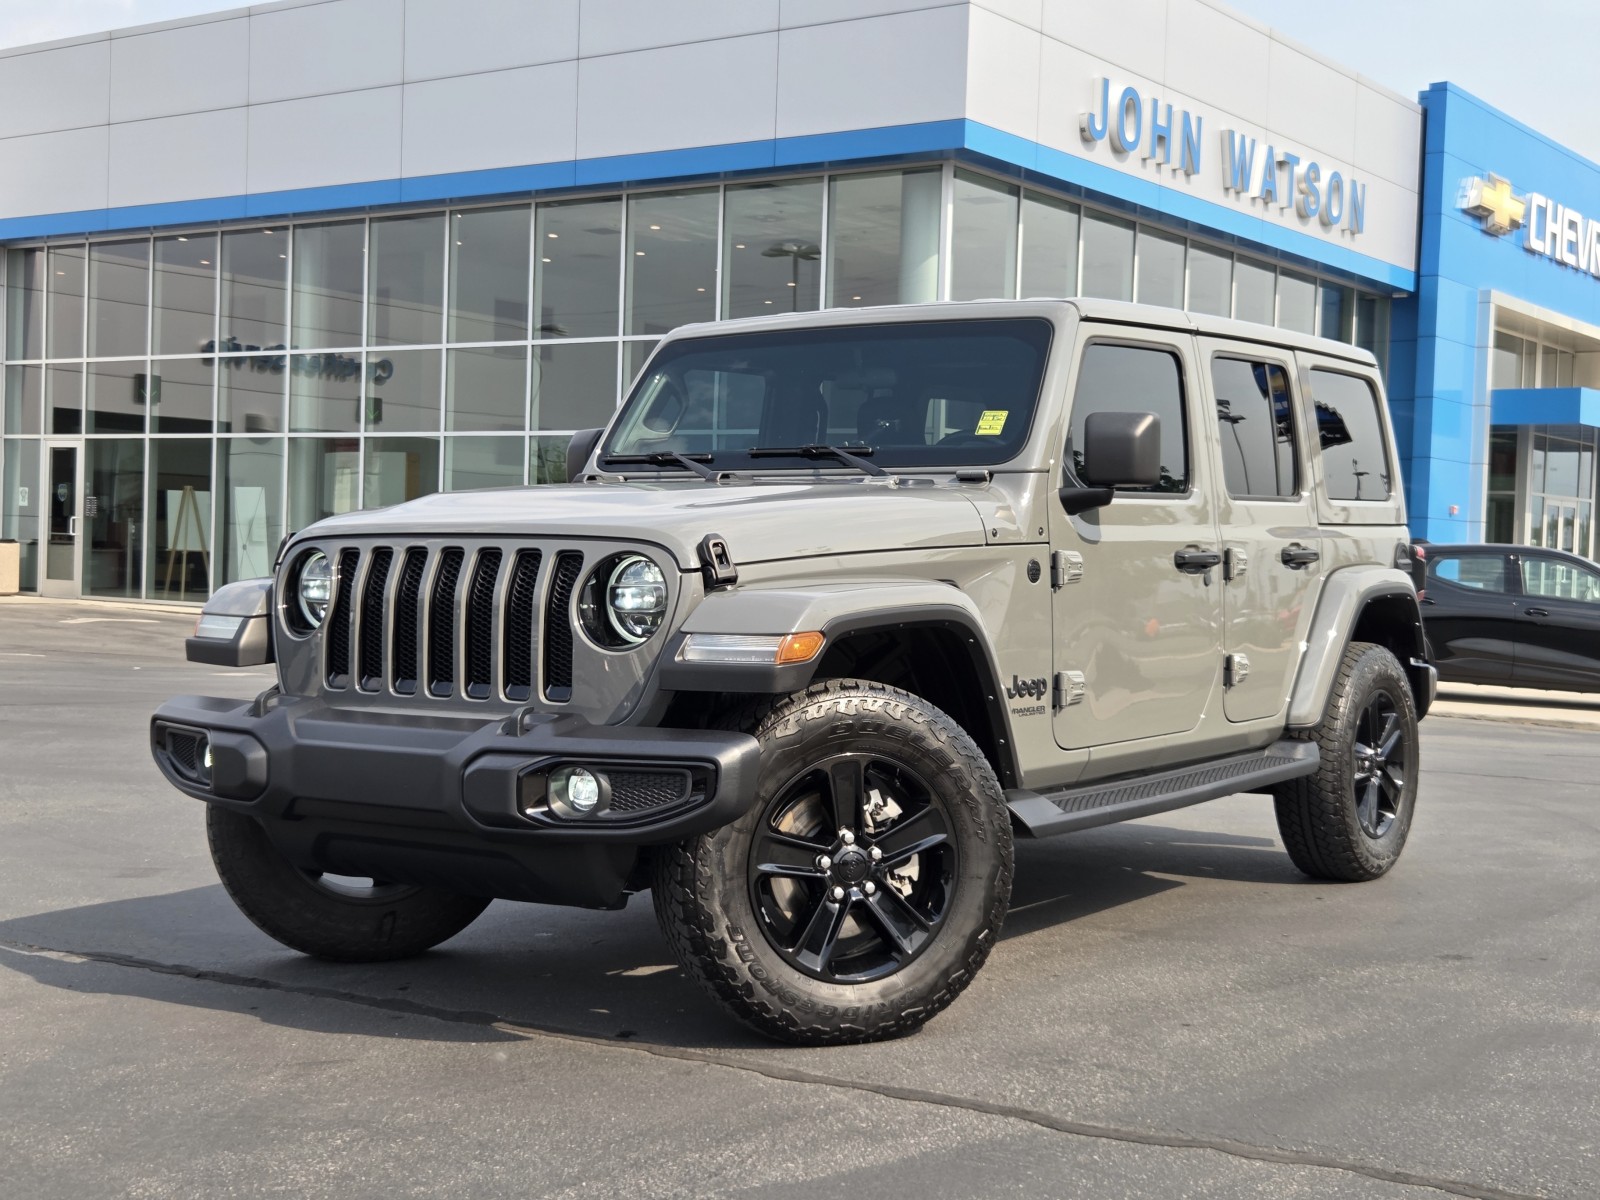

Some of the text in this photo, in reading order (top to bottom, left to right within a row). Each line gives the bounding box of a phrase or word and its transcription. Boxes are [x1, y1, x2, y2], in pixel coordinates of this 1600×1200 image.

[1079, 77, 1366, 235] JOHN WATSON
[1006, 674, 1047, 701] Jeep
[827, 718, 972, 791] DUELER
